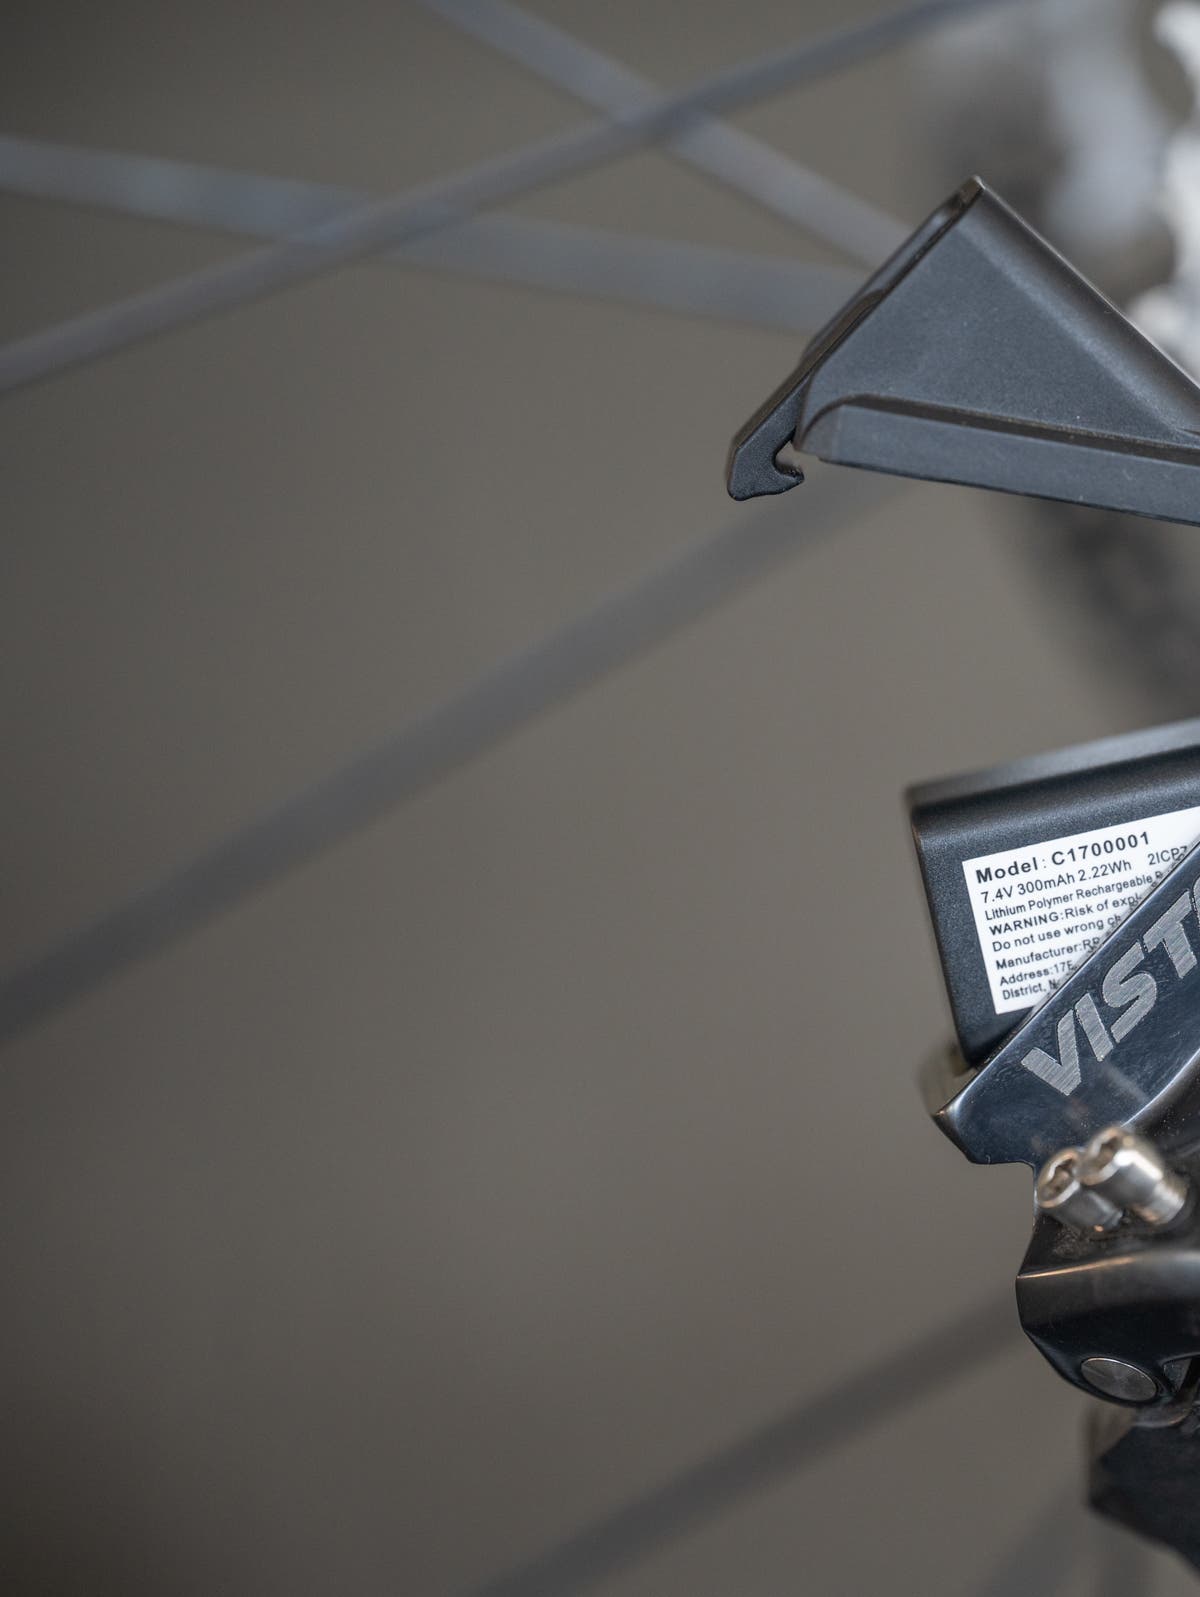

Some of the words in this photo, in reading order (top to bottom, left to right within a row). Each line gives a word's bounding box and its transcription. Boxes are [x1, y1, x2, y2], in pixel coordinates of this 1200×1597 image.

[1051, 831, 1149, 866] C1700001
[981, 885, 1013, 903] 7.4V
[1017, 873, 1075, 895] 300mAh
[1078, 860, 1132, 881] 2.22Wh
[985, 904, 1026, 921] Lithium
[1028, 893, 1073, 910] Polymer
[1076, 874, 1153, 900] Rechargeable
[1096, 899, 1109, 912] of
[992, 940, 1011, 952] Do
[1014, 934, 1035, 947] not
[1037, 929, 1061, 941] use
[1064, 919, 1104, 935] wrong
